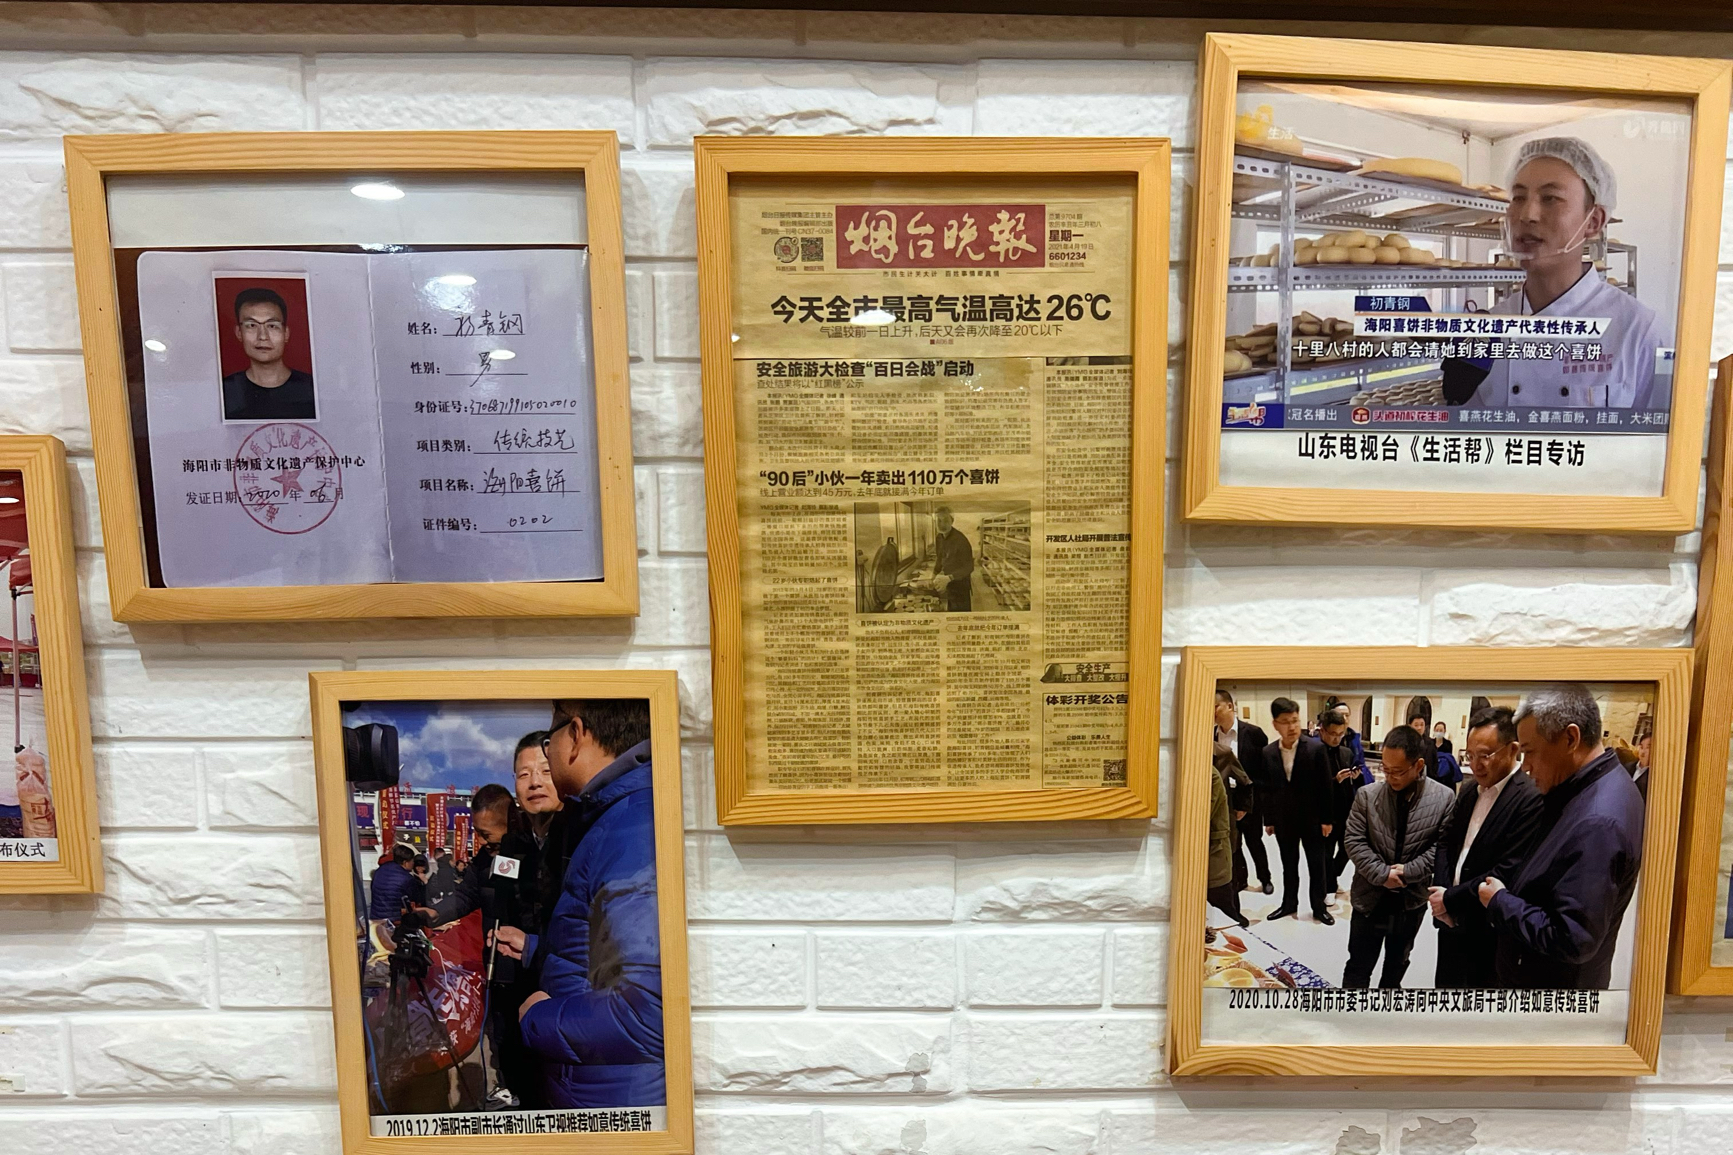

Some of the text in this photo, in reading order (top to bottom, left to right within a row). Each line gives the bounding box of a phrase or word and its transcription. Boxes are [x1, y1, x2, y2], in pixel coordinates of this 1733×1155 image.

[1049, 229, 1084, 242] 星期一
[1049, 252, 1086, 261] 6601234
[1370, 297, 1411, 311] 初青钢
[1364, 317, 1601, 336] 海阳喜饼非物质文化遗产代表性传承人
[1293, 340, 1602, 361] 十里八村的人都会请她到家里去做这个喜饼
[470, 352, 492, 387] 男
[1288, 409, 1338, 421] 冠名播出
[1299, 432, 1586, 467] 山东电视台《生活帮》栏目专访
[182, 455, 366, 473] 海阳市非物质文化遗产保护中心
[759, 468, 1000, 486] “90后”小伙一年卖出110万个喜饼
